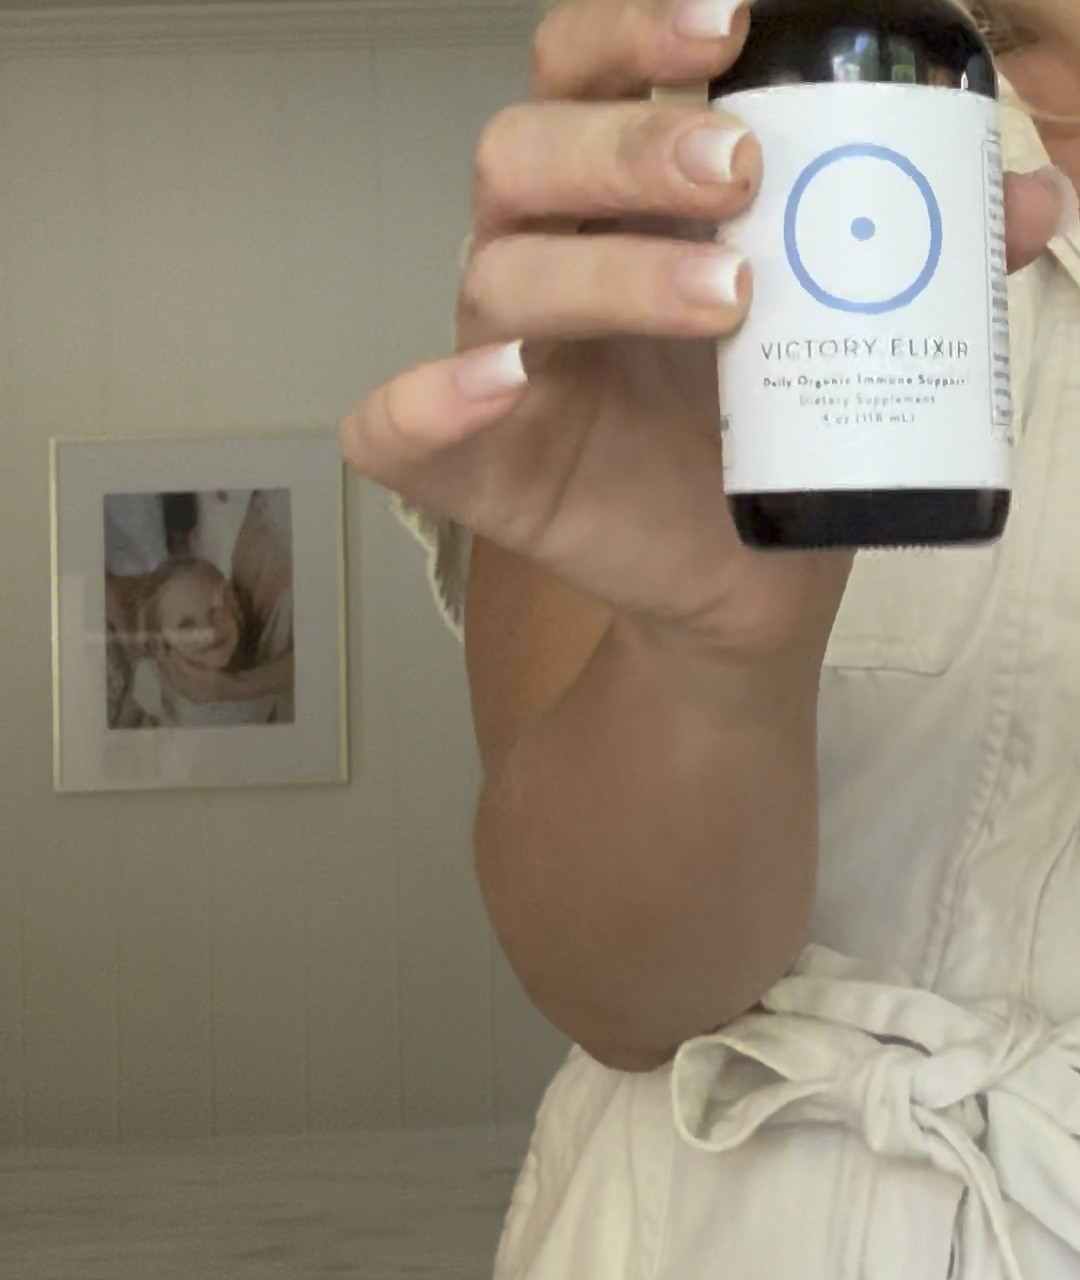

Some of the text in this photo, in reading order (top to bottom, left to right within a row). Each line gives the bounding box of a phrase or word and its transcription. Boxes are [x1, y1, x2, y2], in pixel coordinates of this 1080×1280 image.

[761, 337, 969, 360] VICTORY ELIXIR
[763, 376, 792, 388] Daily
